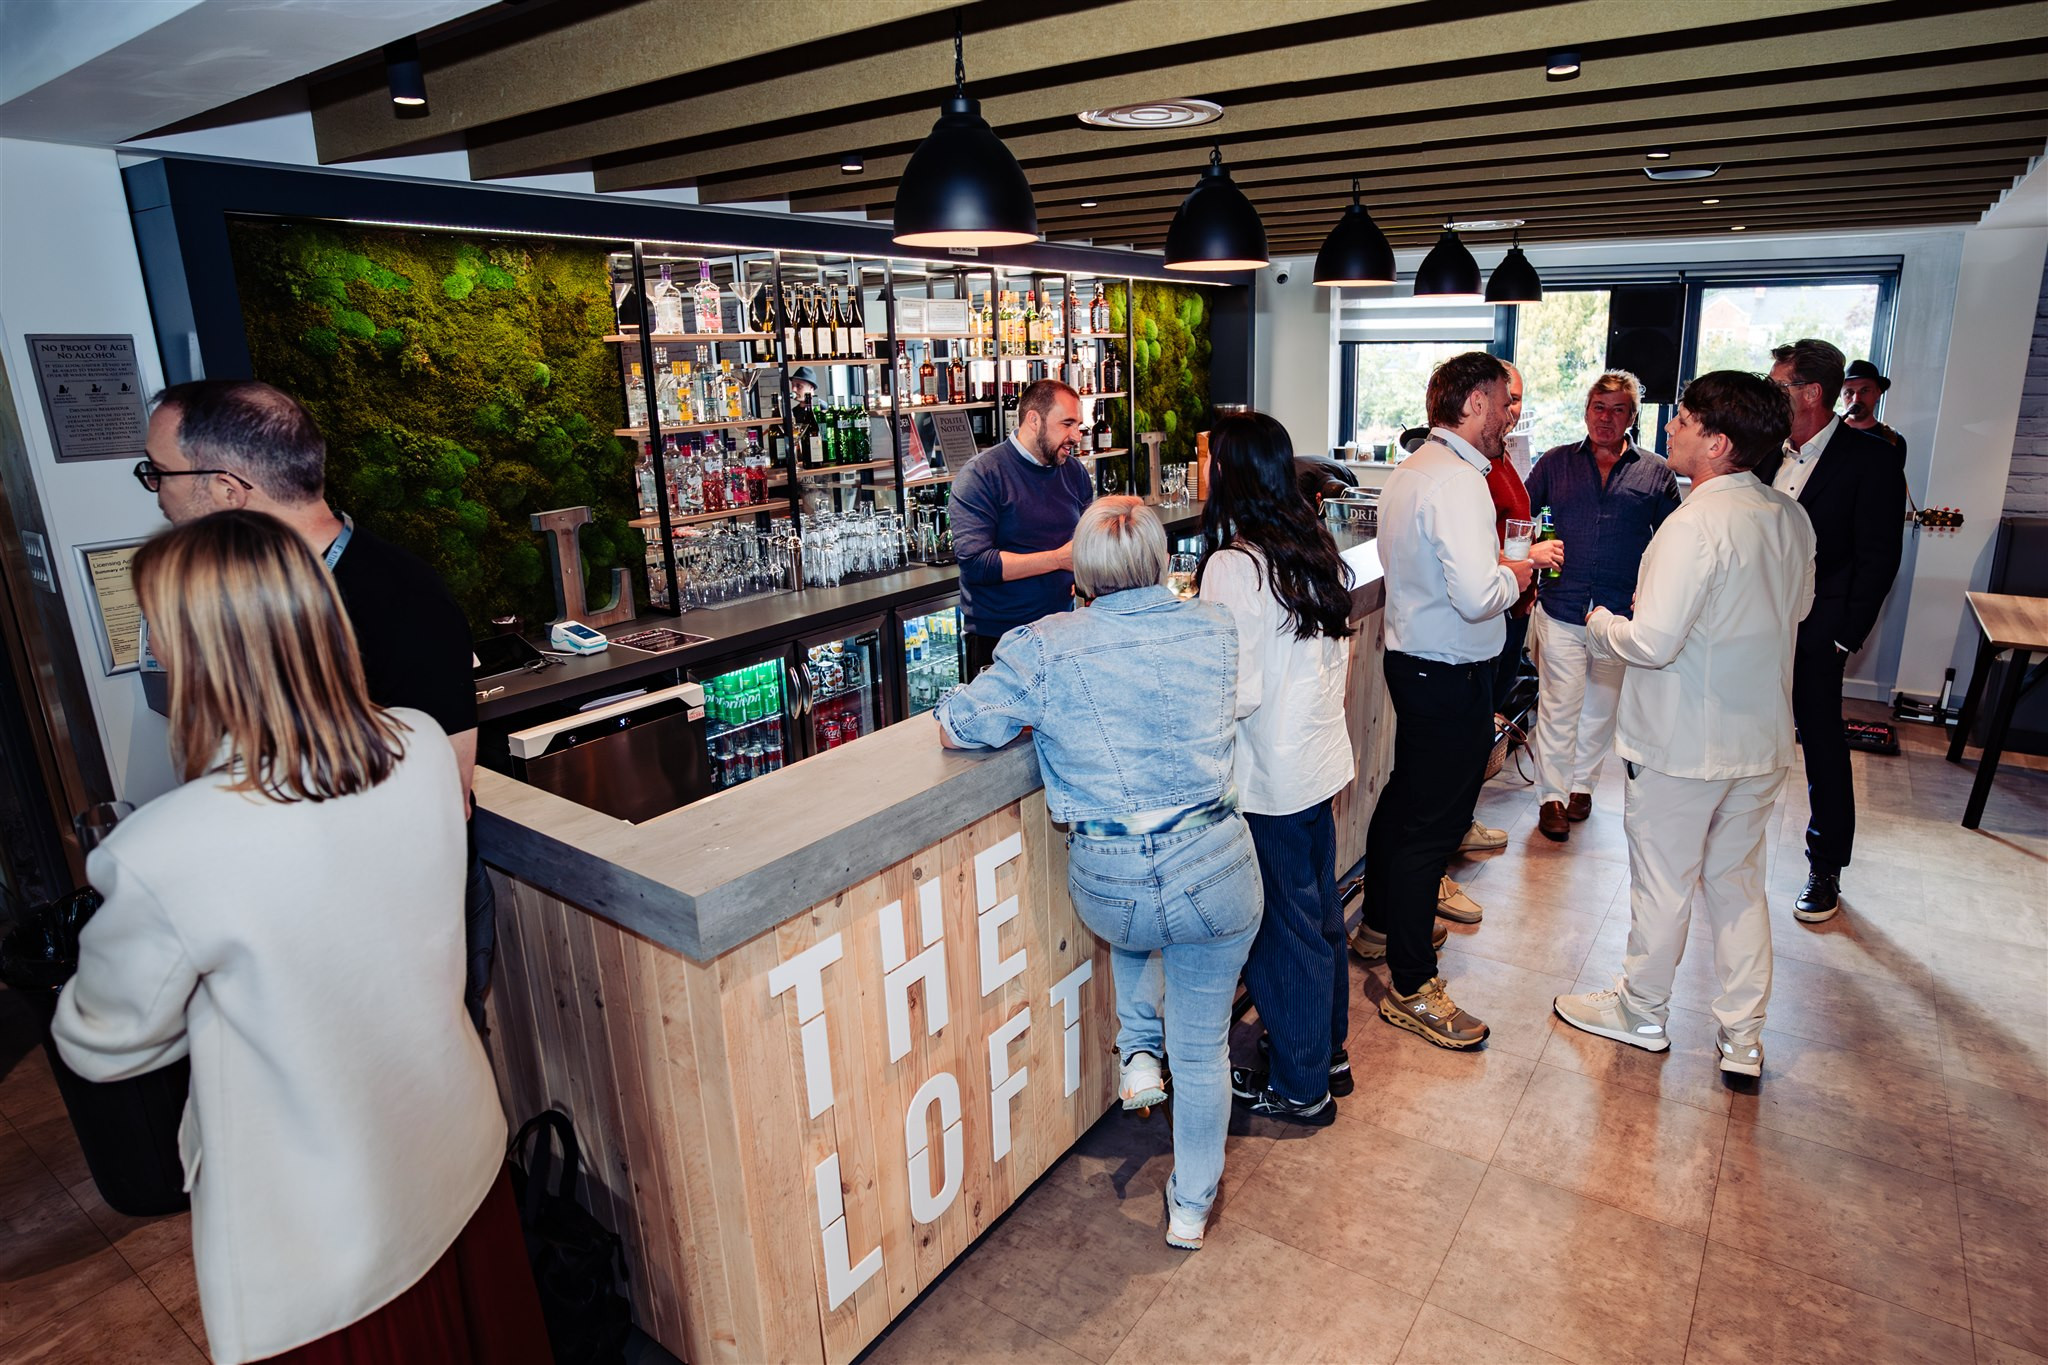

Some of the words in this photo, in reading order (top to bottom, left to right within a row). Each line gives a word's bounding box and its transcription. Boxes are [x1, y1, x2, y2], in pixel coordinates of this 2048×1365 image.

[41, 344, 58, 352] NO
[60, 344, 91, 352] PROOF
[940, 416, 963, 425] POLITE
[941, 425, 967, 433] NOTICE
[93, 560, 122, 569] Licensing
[769, 831, 1029, 1121] THE
[815, 959, 1093, 1312] LOFT
